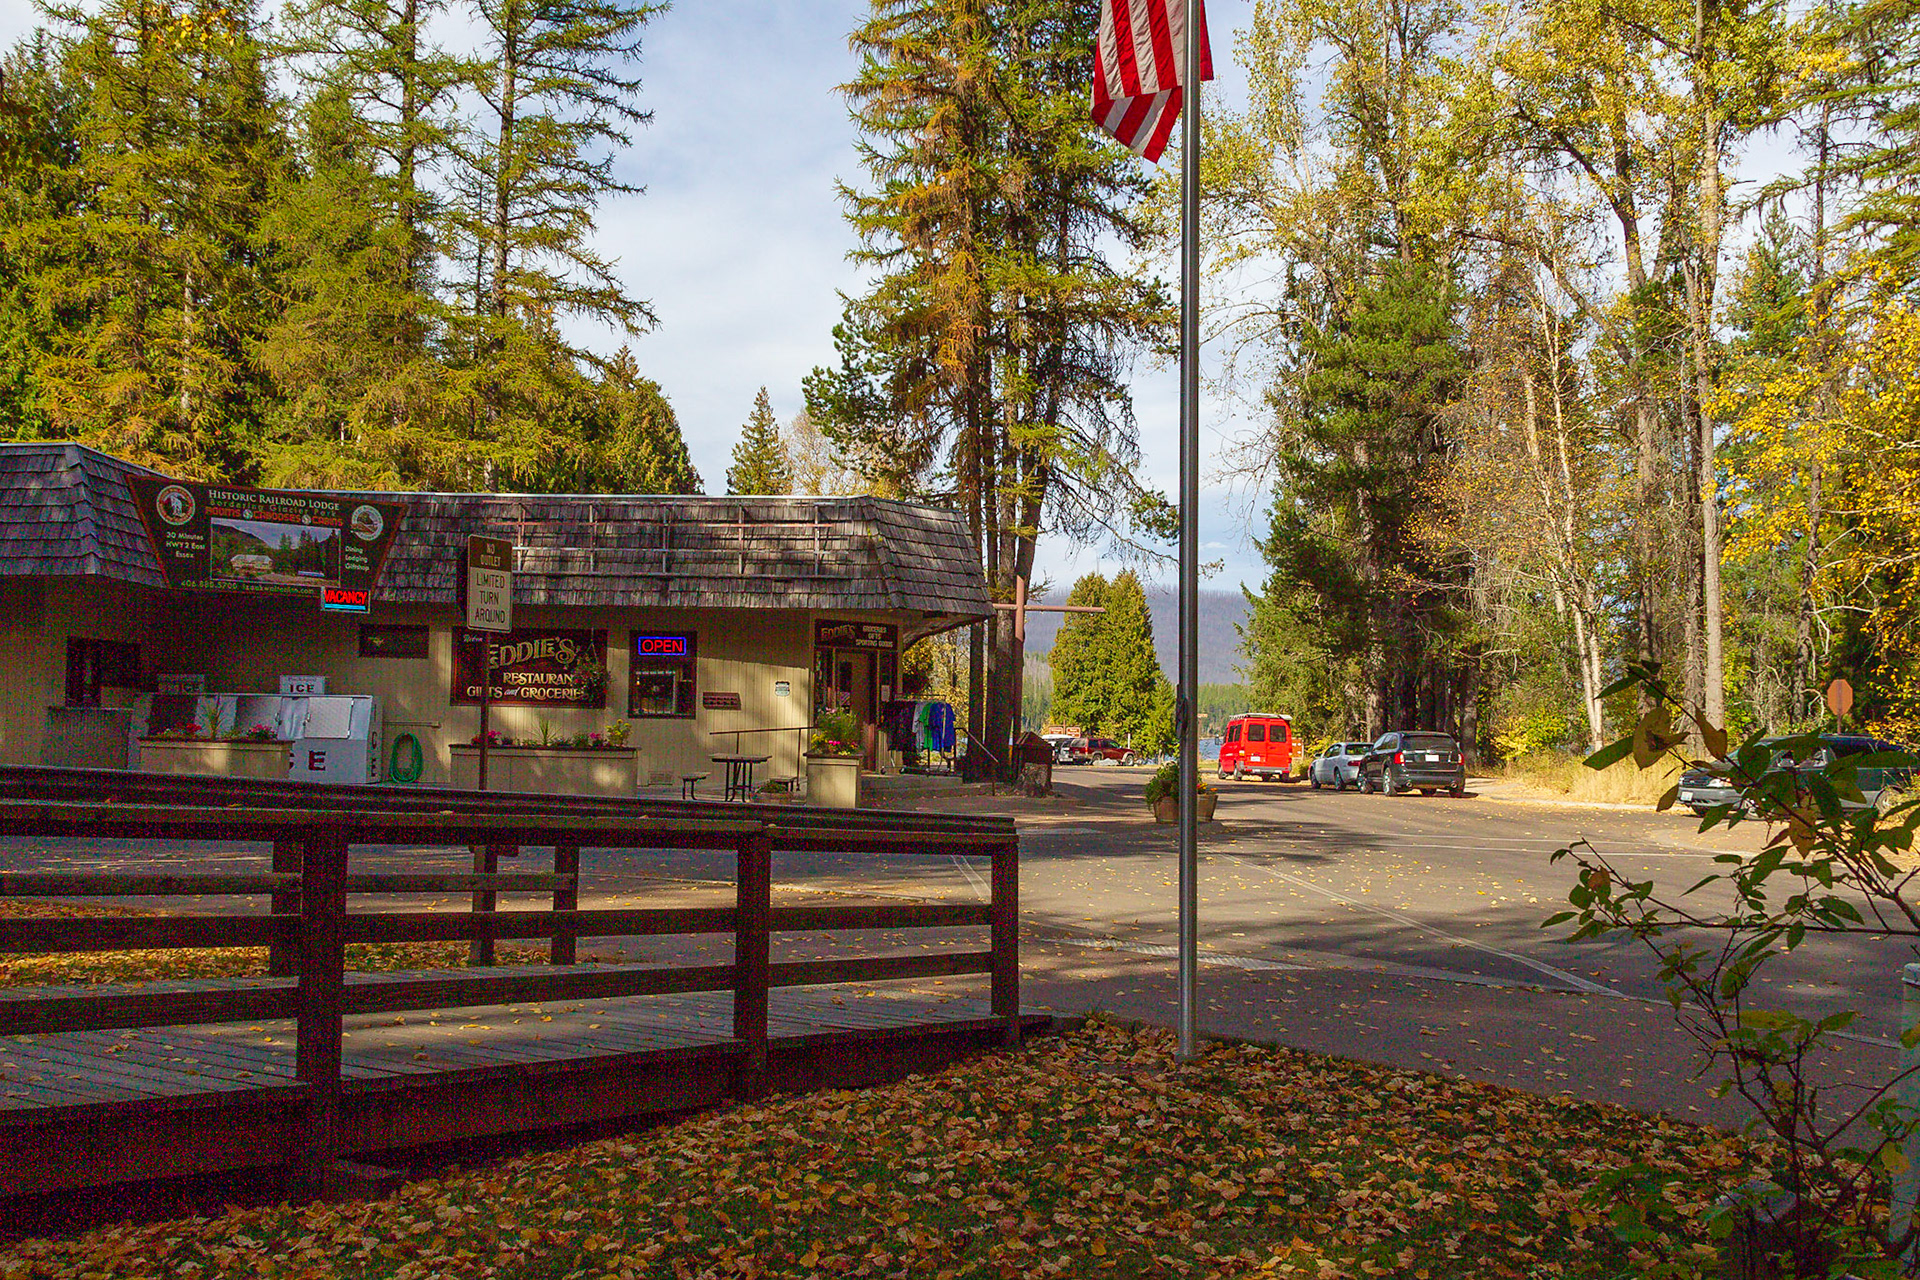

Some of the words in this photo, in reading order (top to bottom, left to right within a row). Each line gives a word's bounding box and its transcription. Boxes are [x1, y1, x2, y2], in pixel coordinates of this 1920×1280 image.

[208, 489, 256, 503] HISTORIC
[259, 494, 306, 508] RAILROAD
[308, 499, 340, 511] LODGE
[166, 531, 177, 539] 30
[178, 532, 204, 541] Minutes
[486, 543, 495, 554] NO
[480, 554, 501, 567] OUTLET
[476, 572, 505, 589] LIMITED
[324, 589, 368, 605] VACANCY
[479, 591, 499, 605] TURN
[474, 607, 506, 624] AROUND
[642, 639, 683, 652] OPEN
[502, 672, 574, 686] RESTAURAN
[290, 684, 315, 693] ICE
